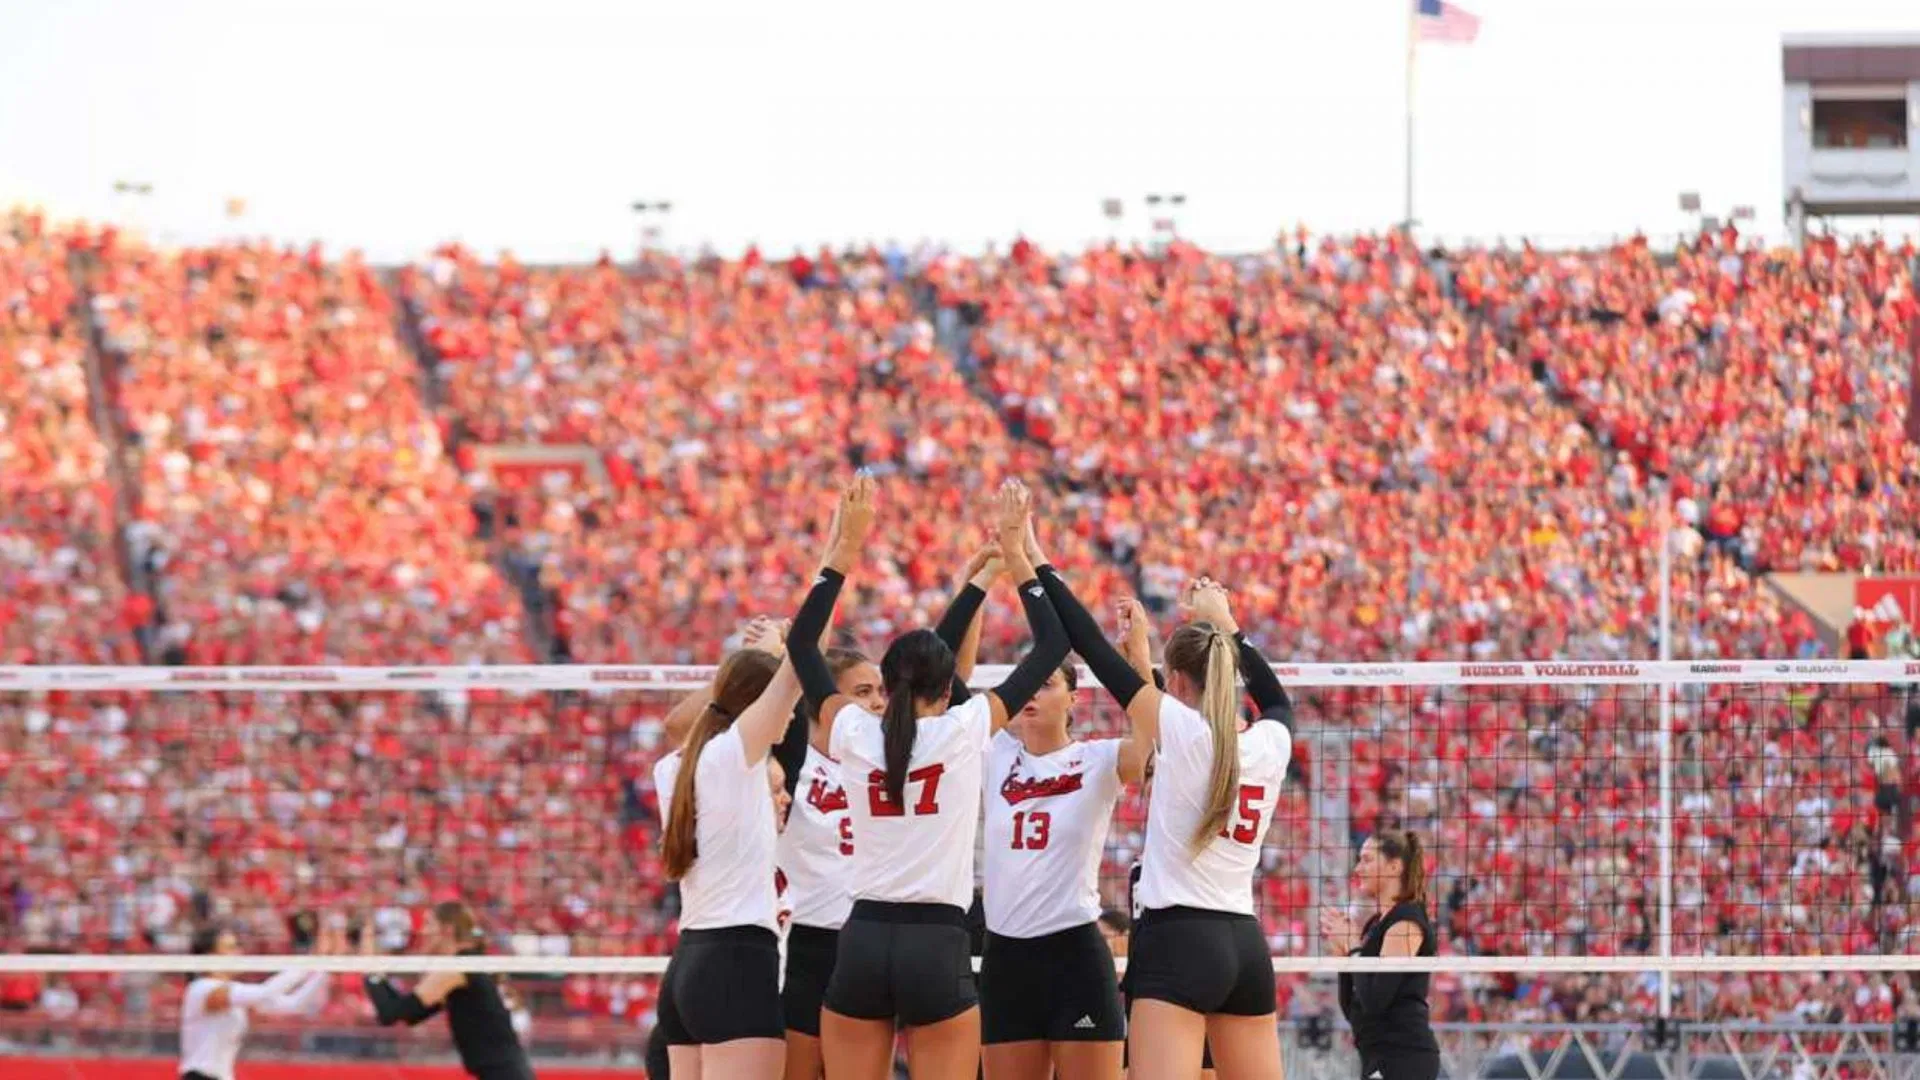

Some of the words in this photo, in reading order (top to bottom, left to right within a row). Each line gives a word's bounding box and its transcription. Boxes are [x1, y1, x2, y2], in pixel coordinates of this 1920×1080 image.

[1460, 665, 1524, 677] HUSKER
[1534, 664, 1640, 677] VOLLEYBALL
[1010, 811, 1052, 850] 13
